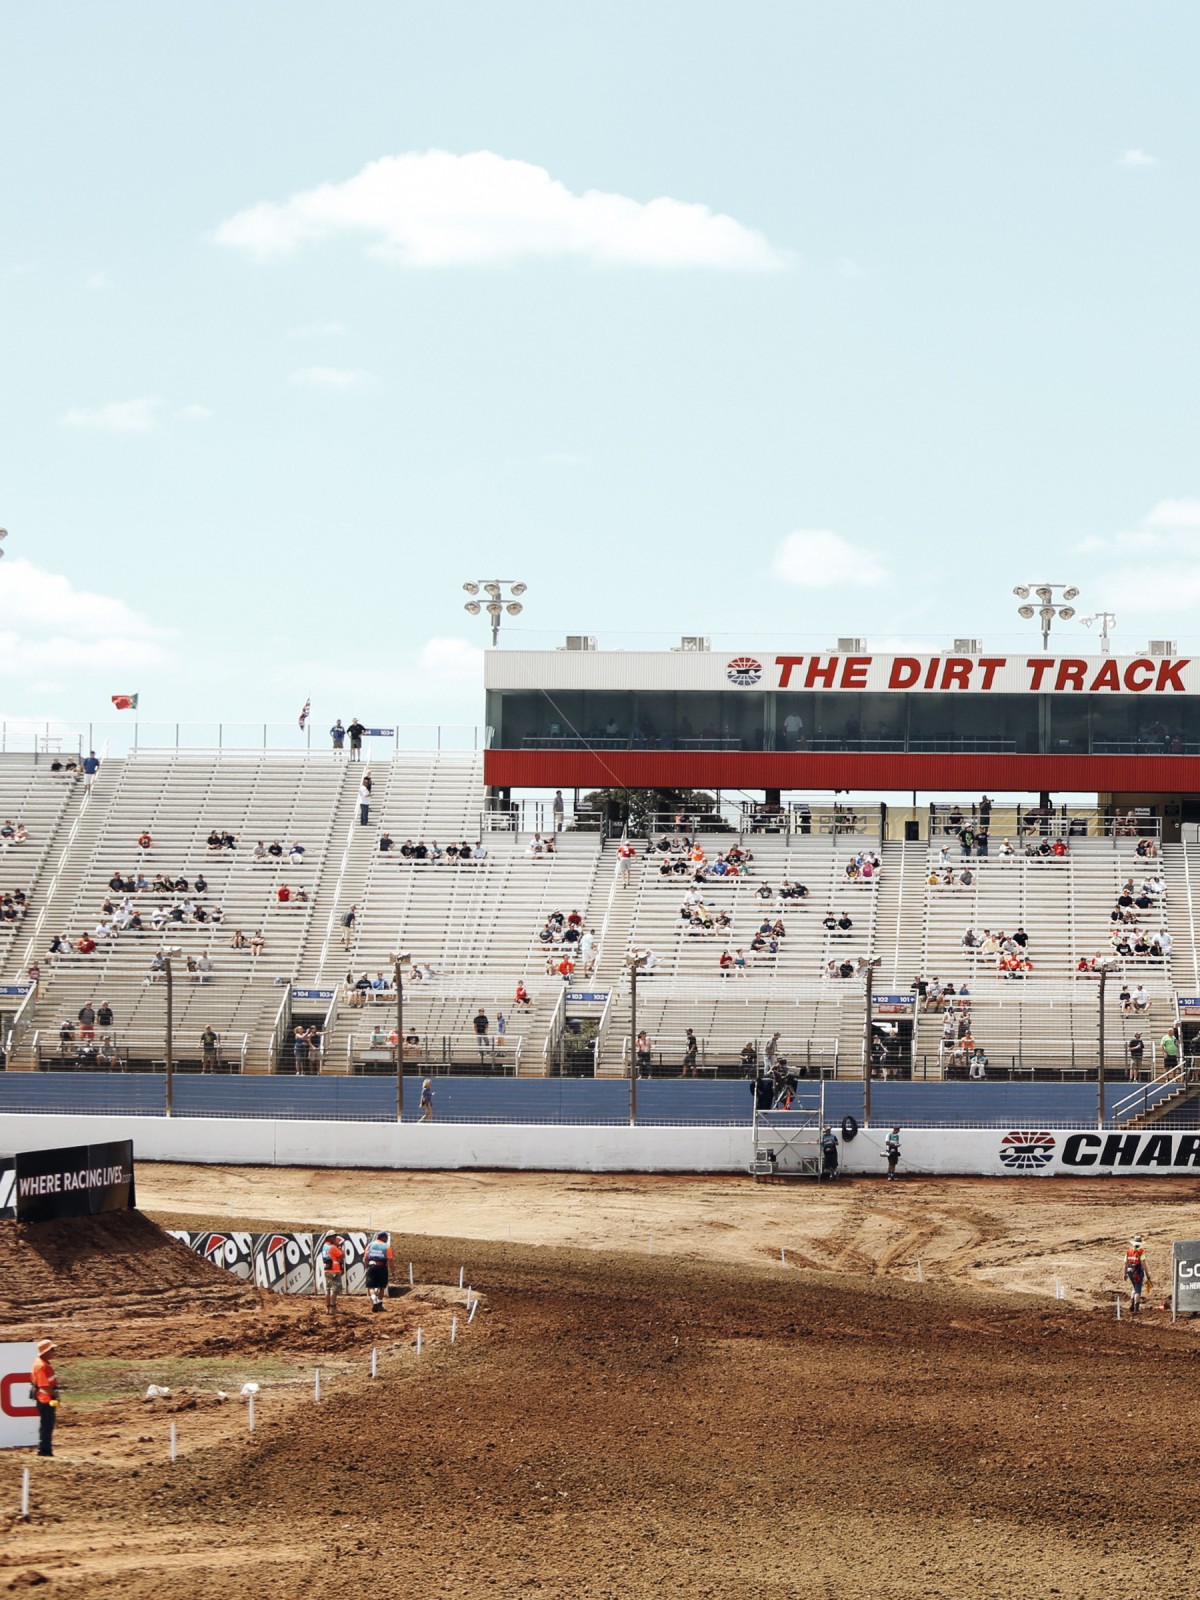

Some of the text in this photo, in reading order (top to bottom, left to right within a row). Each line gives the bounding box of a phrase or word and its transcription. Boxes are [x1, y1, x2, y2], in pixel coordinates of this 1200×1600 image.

[775, 656, 872, 688] THE
[888, 657, 1006, 690] DIRT
[1027, 659, 1191, 692] TRACK
[20, 1173, 61, 1197] WHERE
[63, 1168, 103, 1191] RACING
